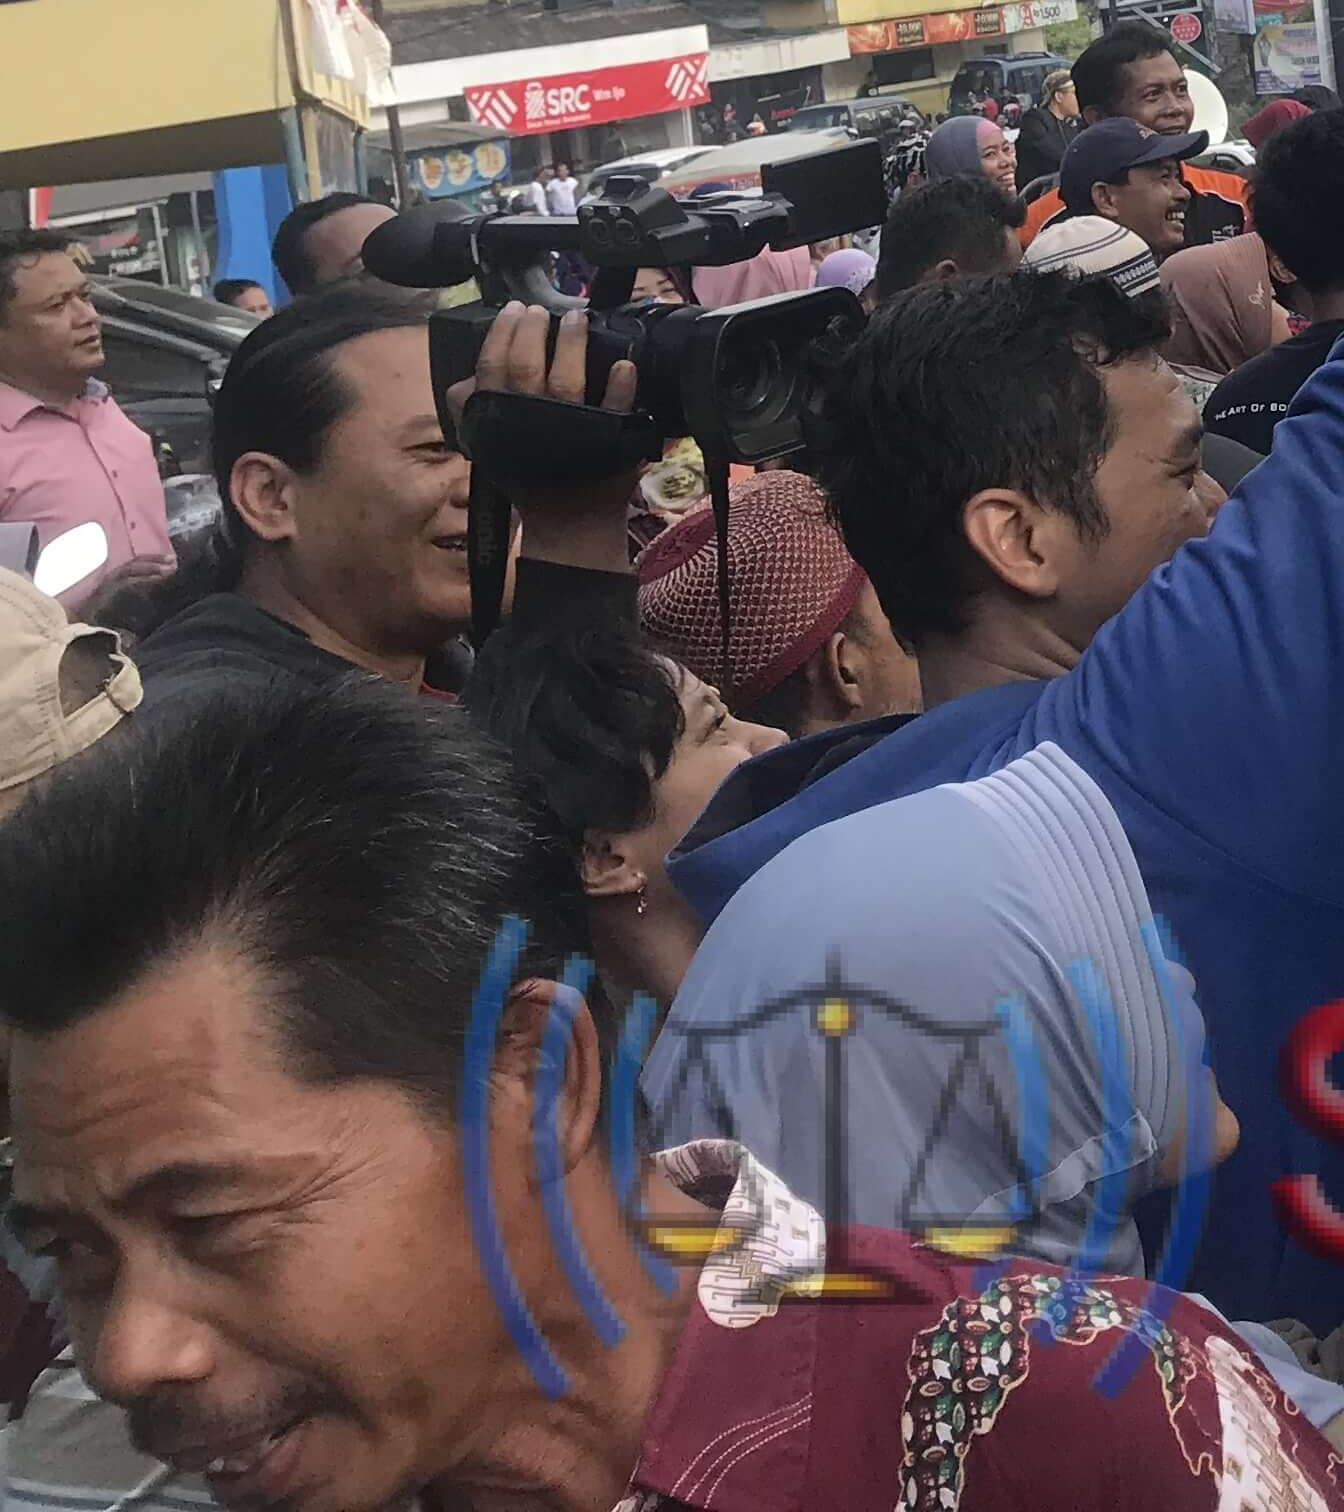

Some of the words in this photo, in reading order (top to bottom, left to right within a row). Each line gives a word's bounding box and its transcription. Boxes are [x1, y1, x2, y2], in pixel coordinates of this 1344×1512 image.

[546, 84, 591, 116] SRC
[1228, 405, 1247, 416] ART
[1250, 403, 1266, 413] OF
[1270, 402, 1288, 413] BO
